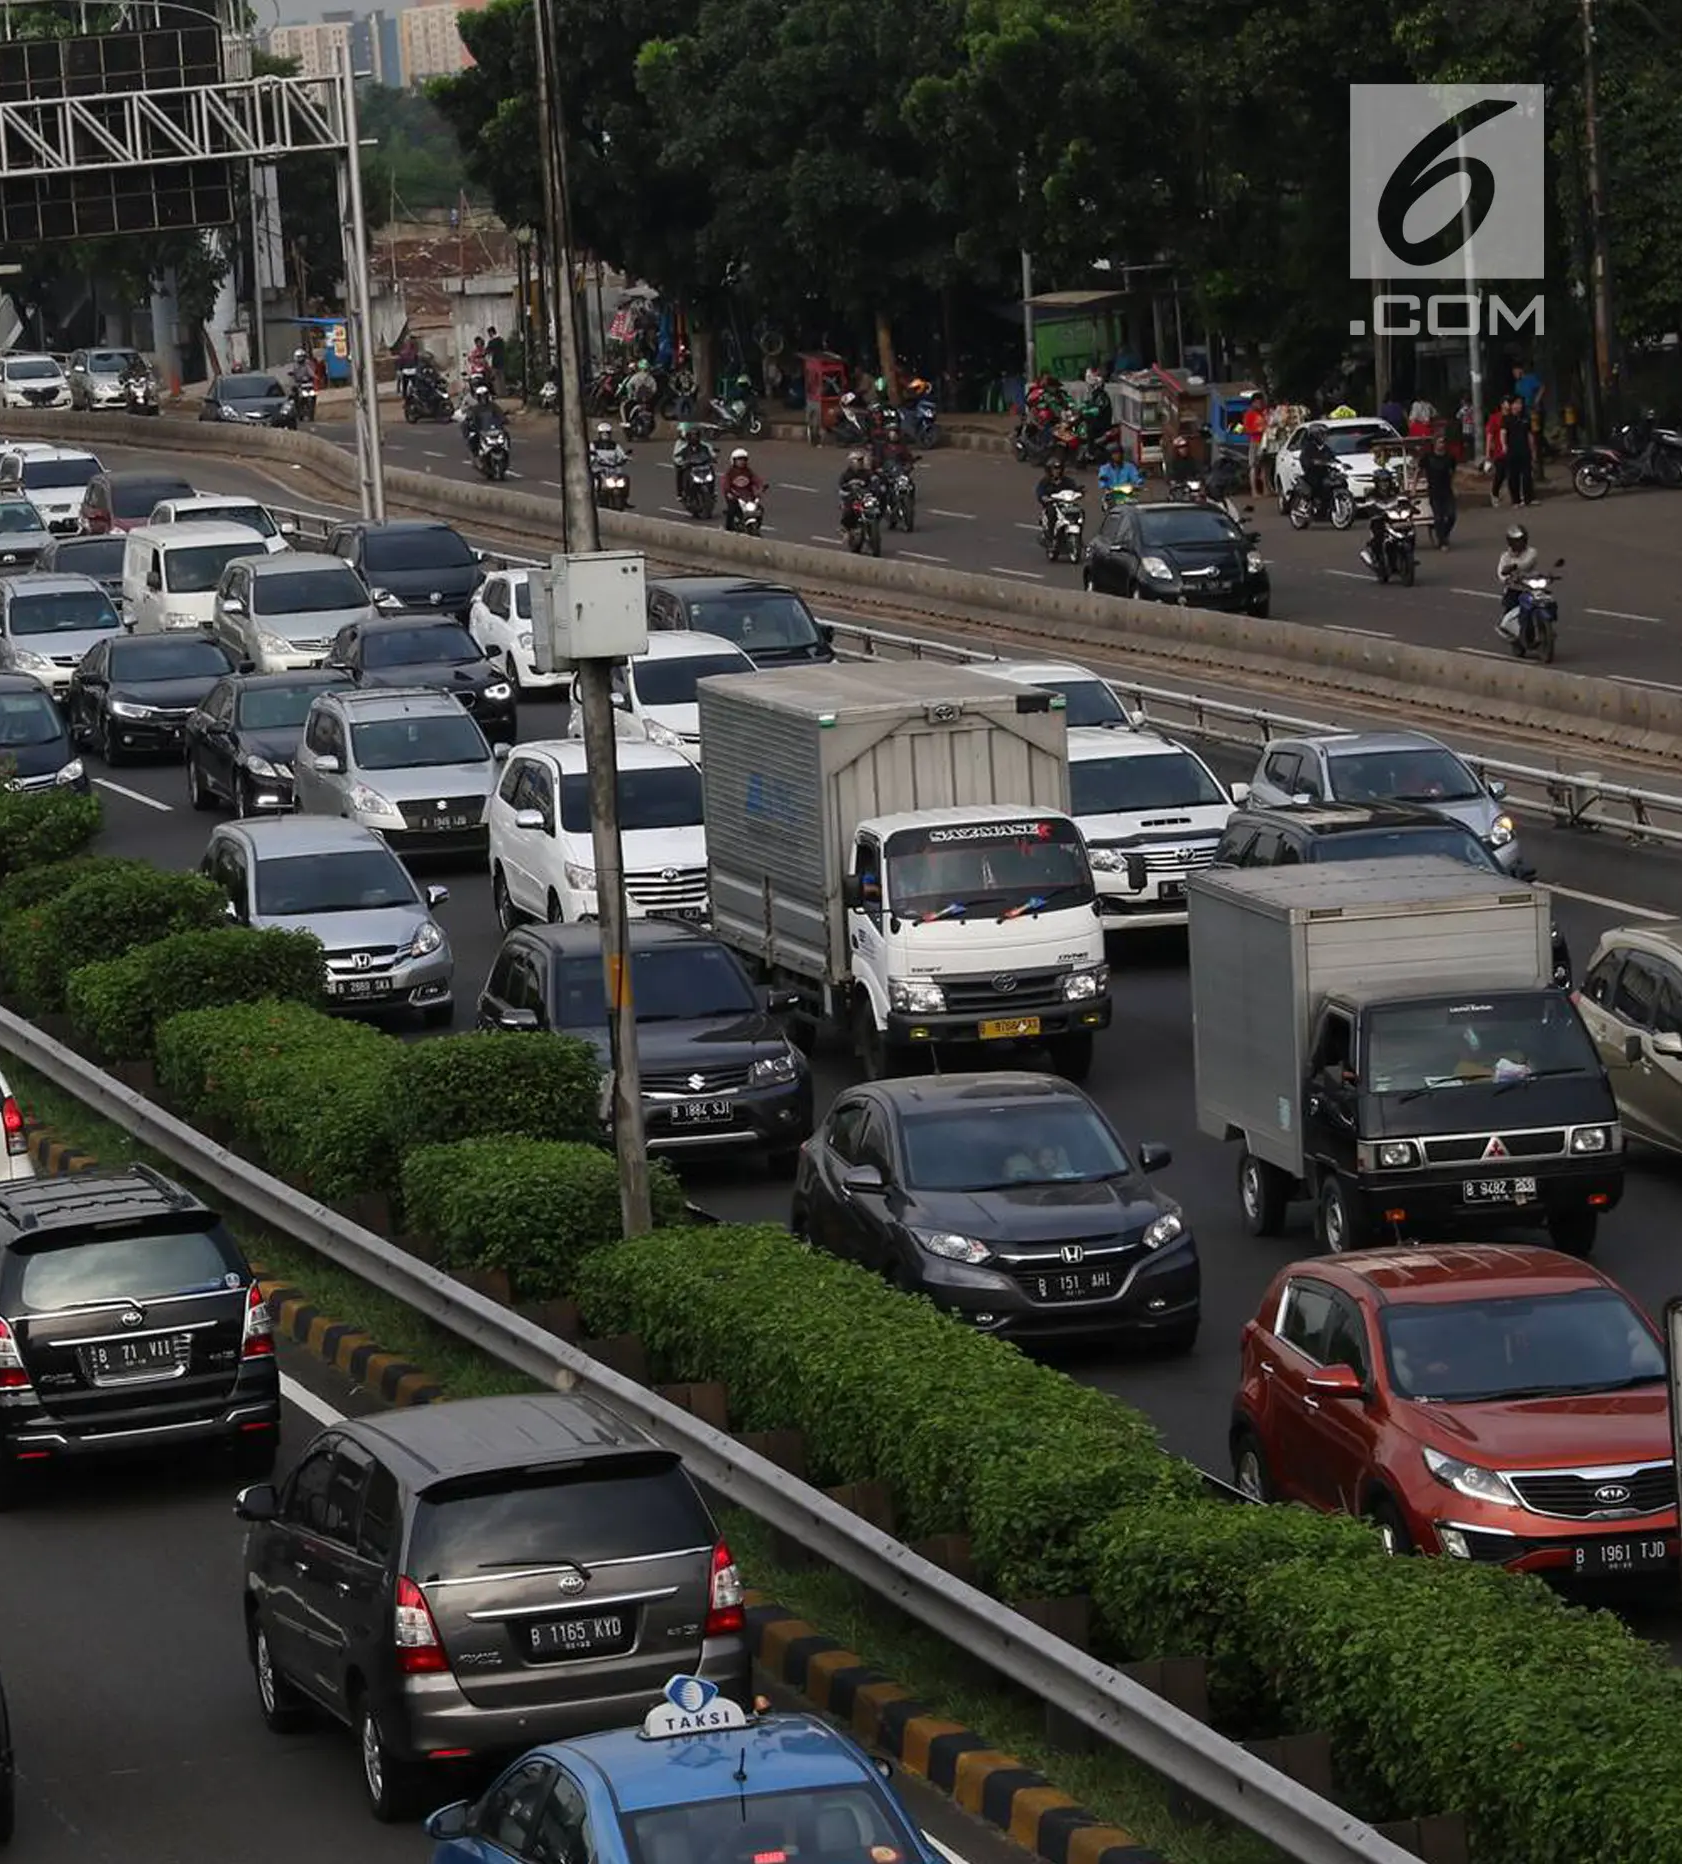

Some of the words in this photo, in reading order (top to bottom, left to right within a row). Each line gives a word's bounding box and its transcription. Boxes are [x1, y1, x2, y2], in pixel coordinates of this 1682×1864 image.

[1060, 1275, 1079, 1290] 151
[97, 1348, 108, 1363] B
[1599, 1488, 1625, 1500] KIA
[1575, 1547, 1585, 1565] B
[1601, 1543, 1631, 1562] 1961
[1640, 1540, 1666, 1558] TJD
[530, 1629, 541, 1646] B
[551, 1623, 586, 1643] 1165
[593, 1617, 622, 1638] KYD
[665, 1711, 730, 1731] TAKSI
